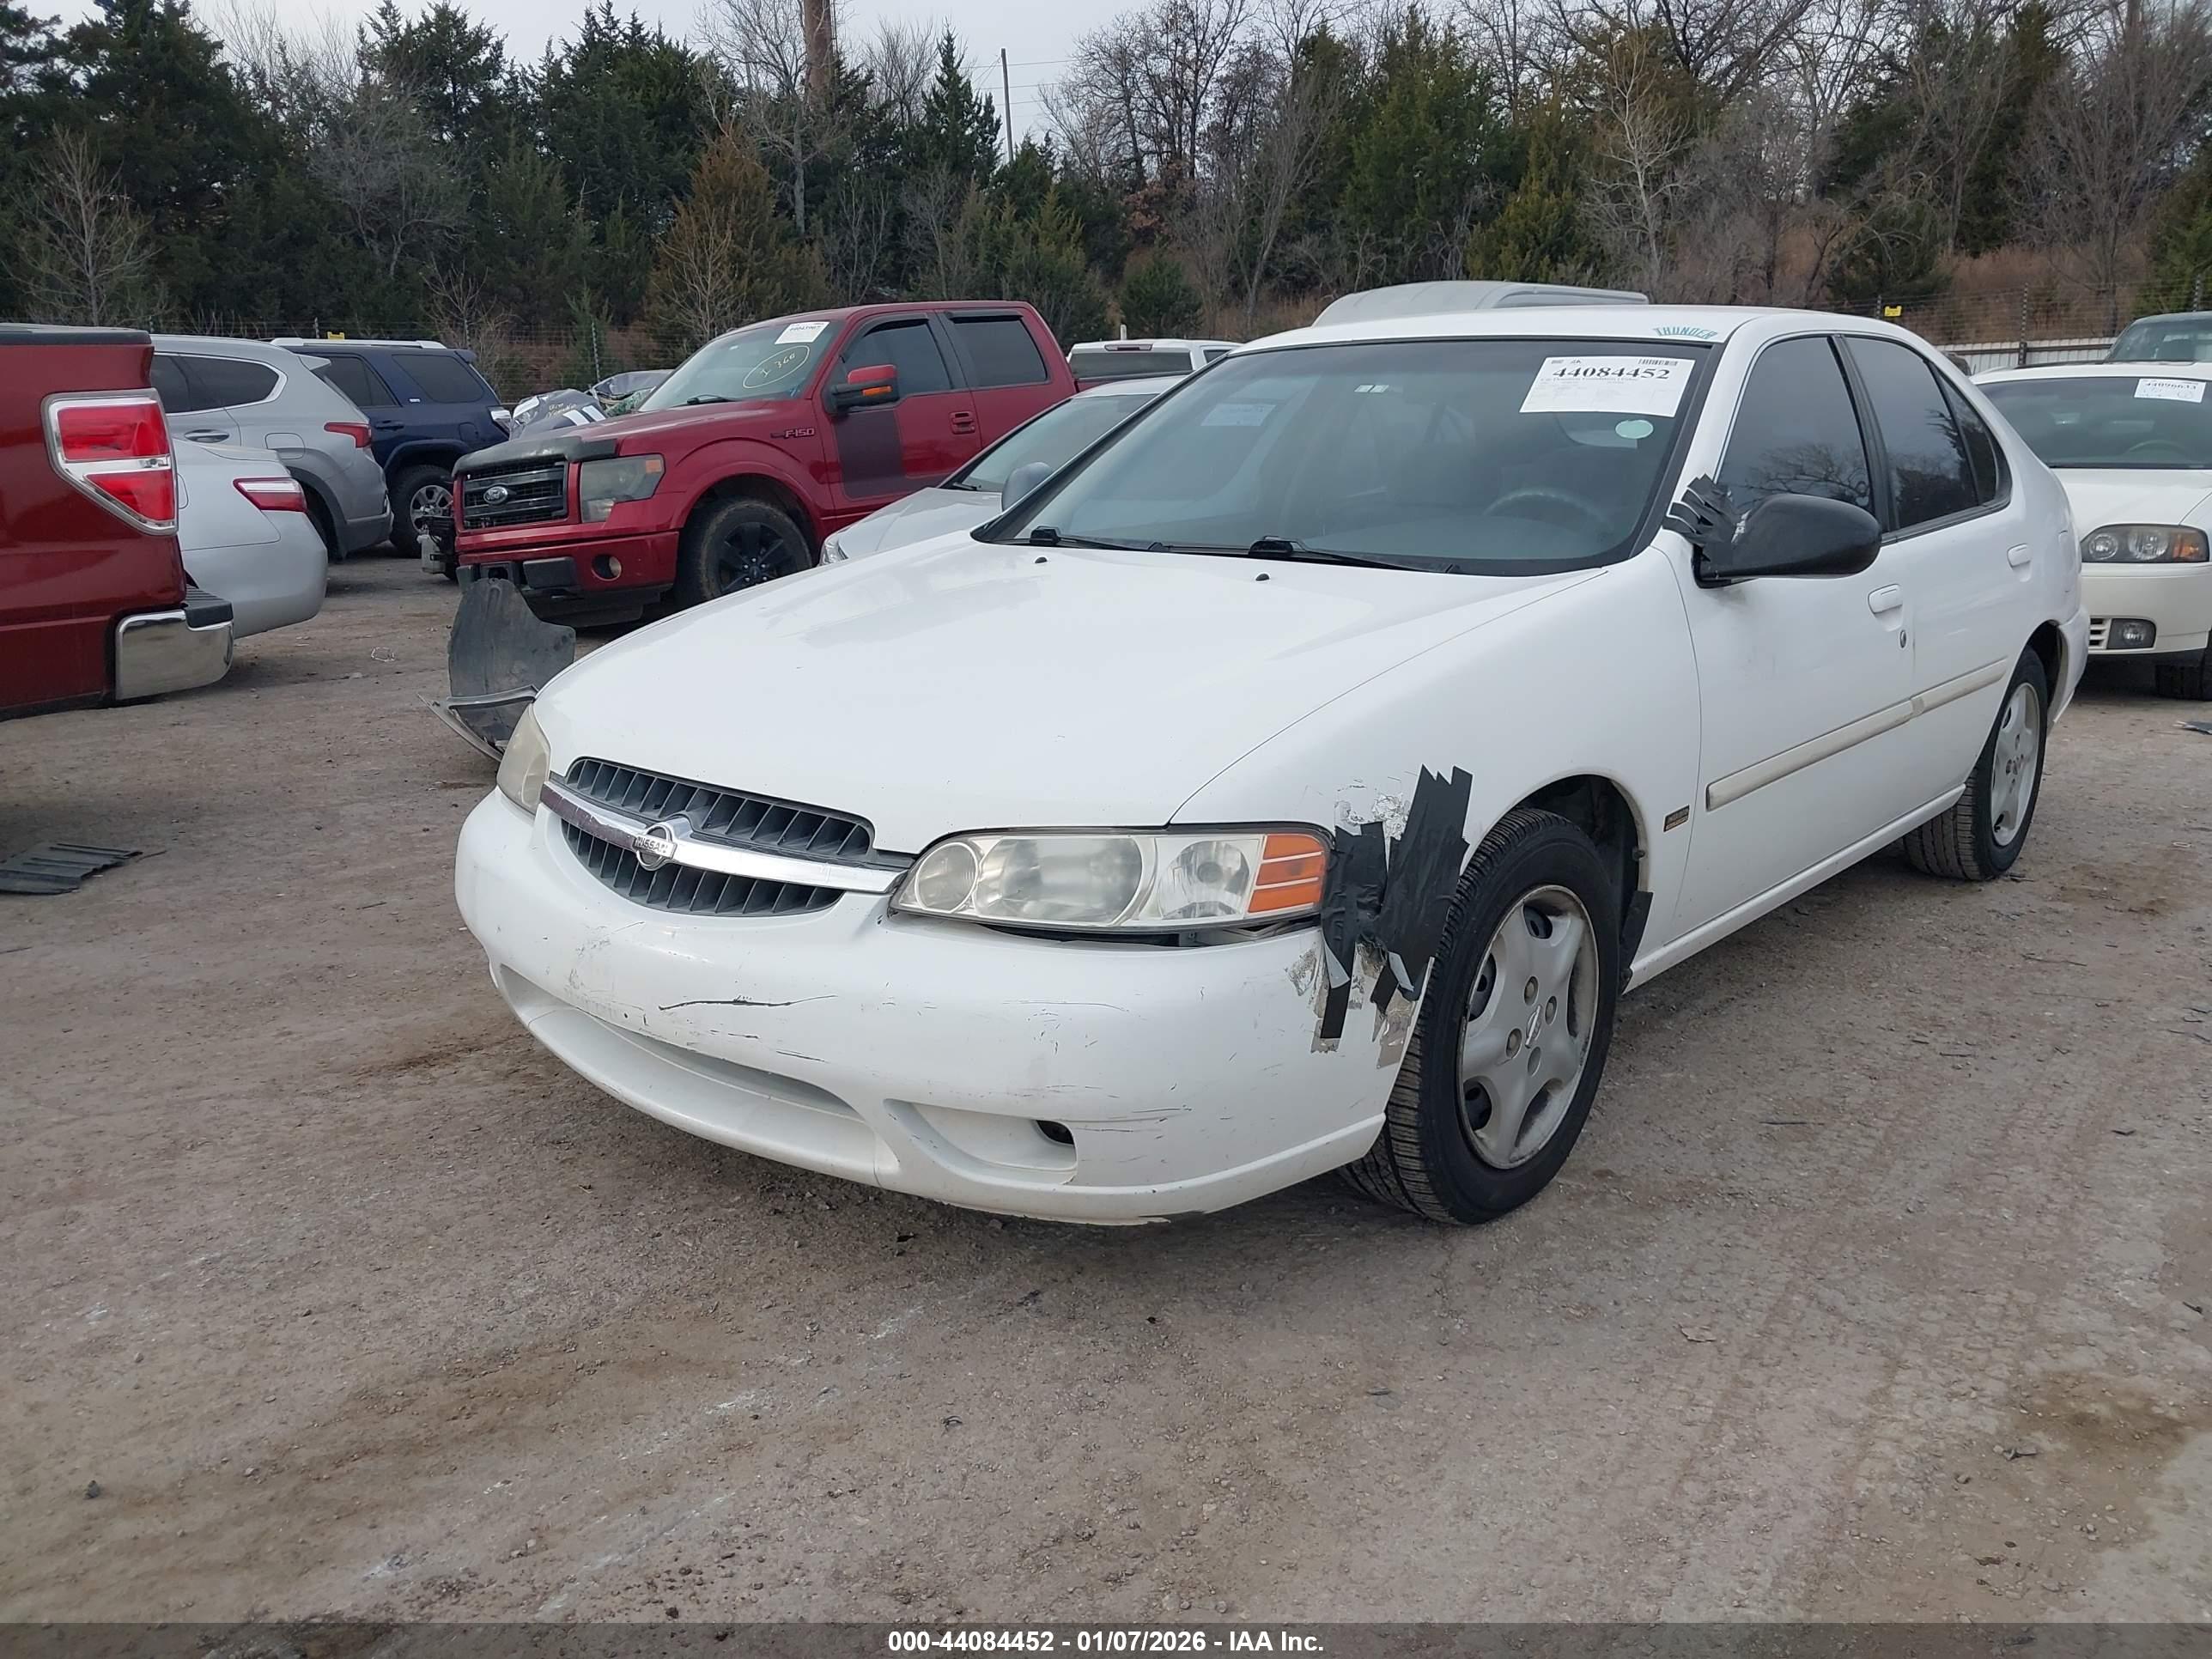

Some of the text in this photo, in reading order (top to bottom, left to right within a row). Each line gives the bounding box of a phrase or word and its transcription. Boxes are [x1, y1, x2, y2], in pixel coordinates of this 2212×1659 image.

[1653, 326, 1718, 339] THUNDER
[1553, 367, 1670, 380] 44084452
[785, 428, 815, 438] F-150
